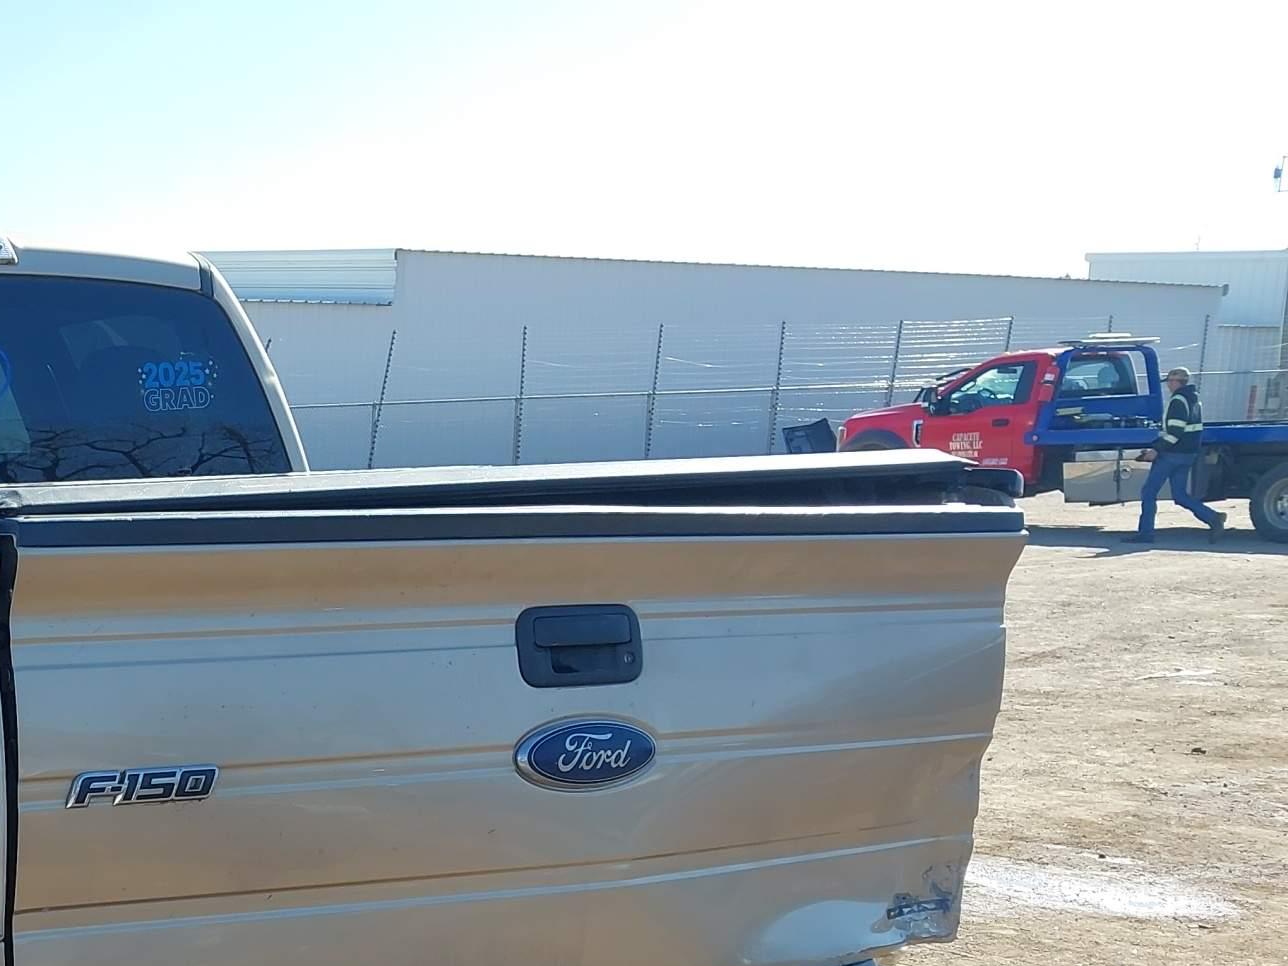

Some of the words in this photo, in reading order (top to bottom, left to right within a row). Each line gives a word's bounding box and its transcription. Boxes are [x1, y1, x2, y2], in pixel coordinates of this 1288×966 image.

[143, 361, 205, 388] 2025
[143, 386, 210, 412] GRAD
[557, 733, 632, 773] Ford
[65, 763, 220, 809] F-150
